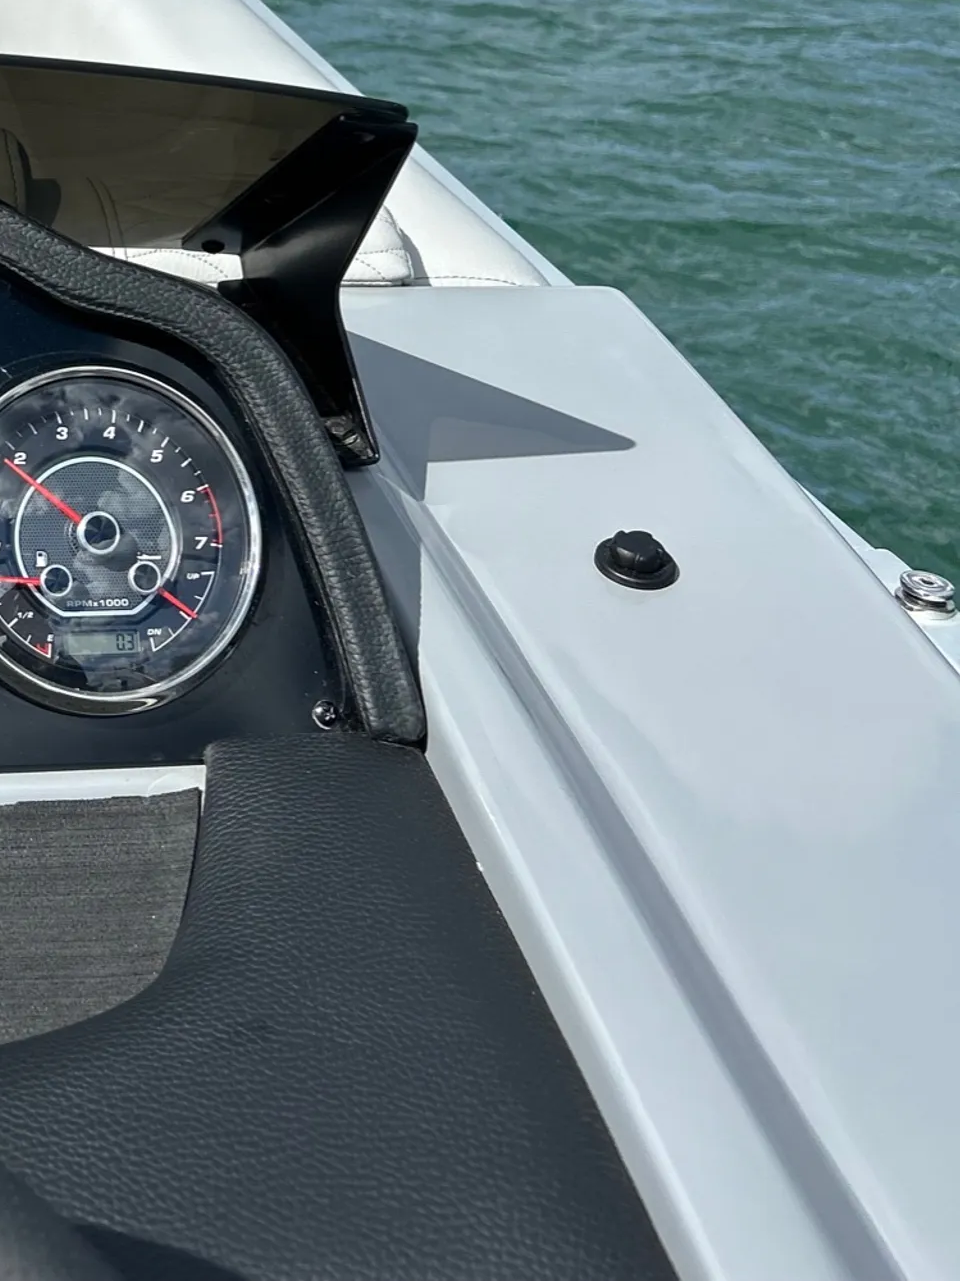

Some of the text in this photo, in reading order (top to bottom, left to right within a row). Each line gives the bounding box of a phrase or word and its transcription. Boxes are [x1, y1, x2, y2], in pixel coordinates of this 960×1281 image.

[56, 427, 69, 440] 3
[103, 427, 116, 439] 4
[13, 452, 27, 465] 2
[150, 450, 164, 463] 5
[180, 491, 195, 503] 6
[194, 537, 208, 550] 7
[17, 611, 34, 619] 1/2
